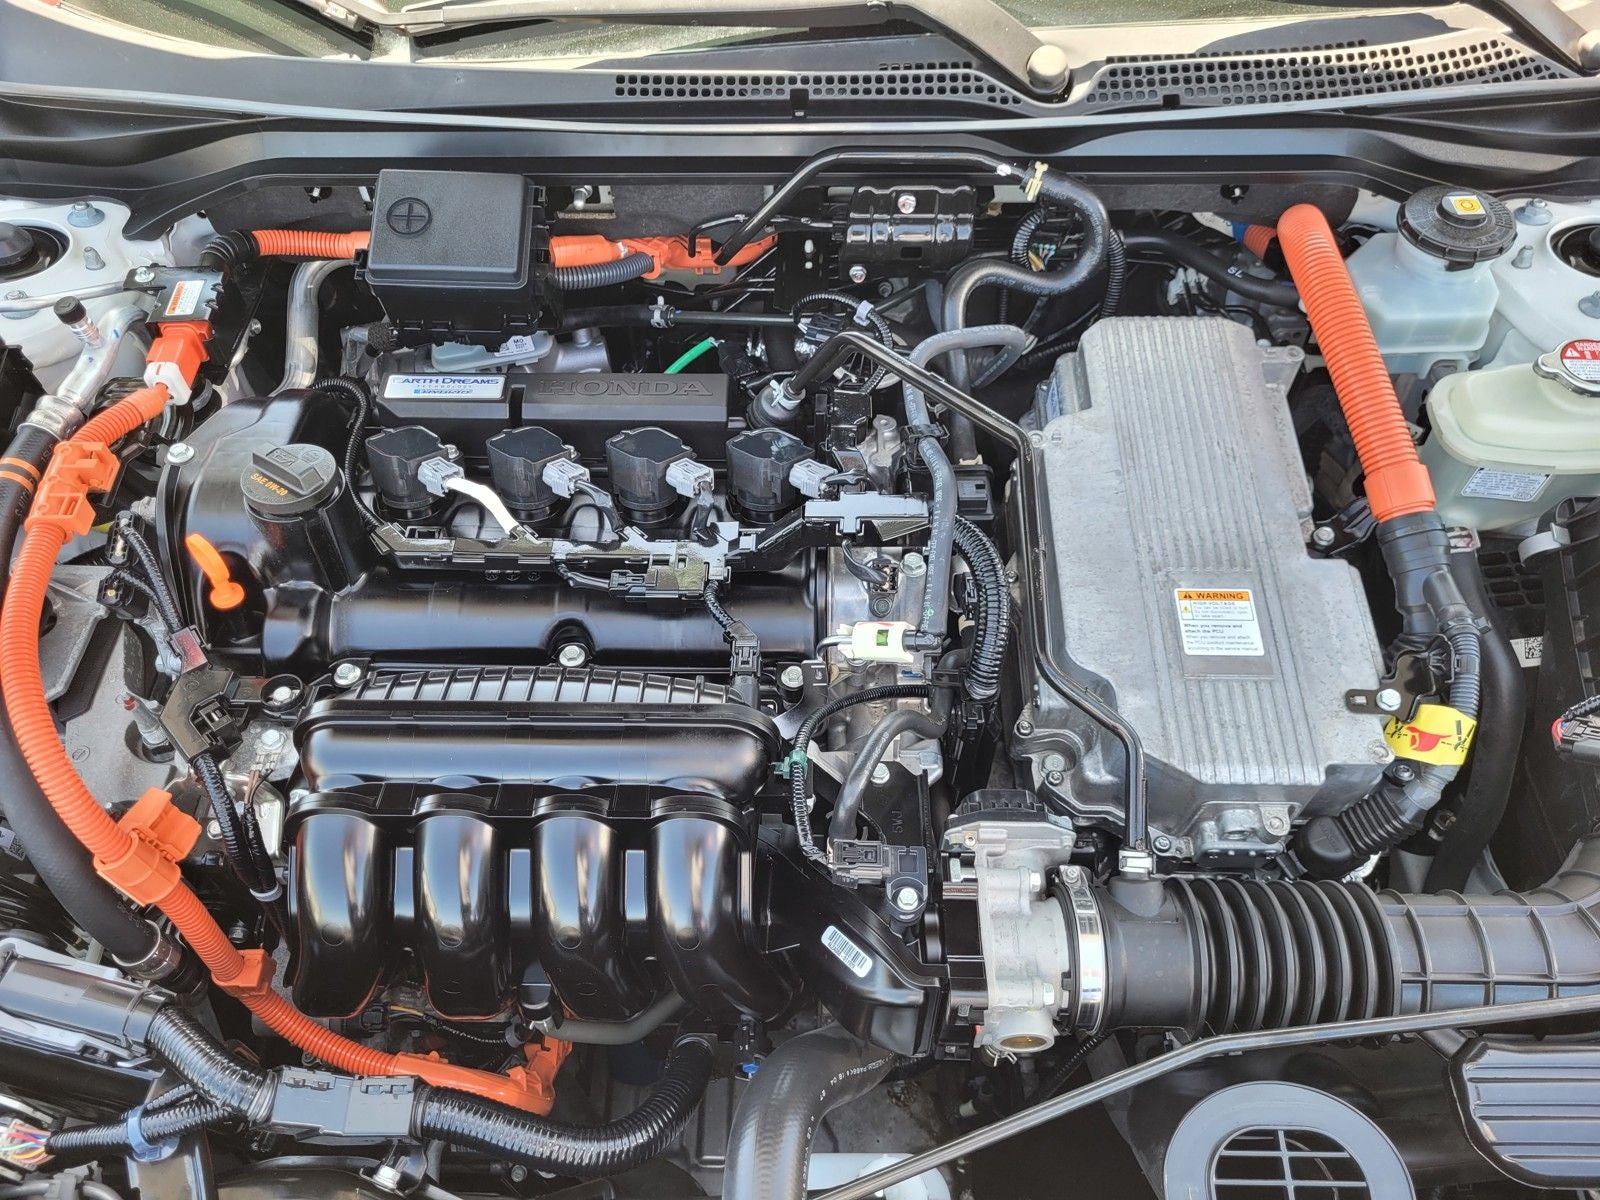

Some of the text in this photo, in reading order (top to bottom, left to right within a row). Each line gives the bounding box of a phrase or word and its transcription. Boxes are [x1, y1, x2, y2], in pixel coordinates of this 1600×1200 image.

[441, 377, 499, 385] DREAMS
[538, 380, 713, 396] HONDA
[250, 472, 288, 496] SAE 0W-20
[1196, 592, 1244, 600] WARNING
